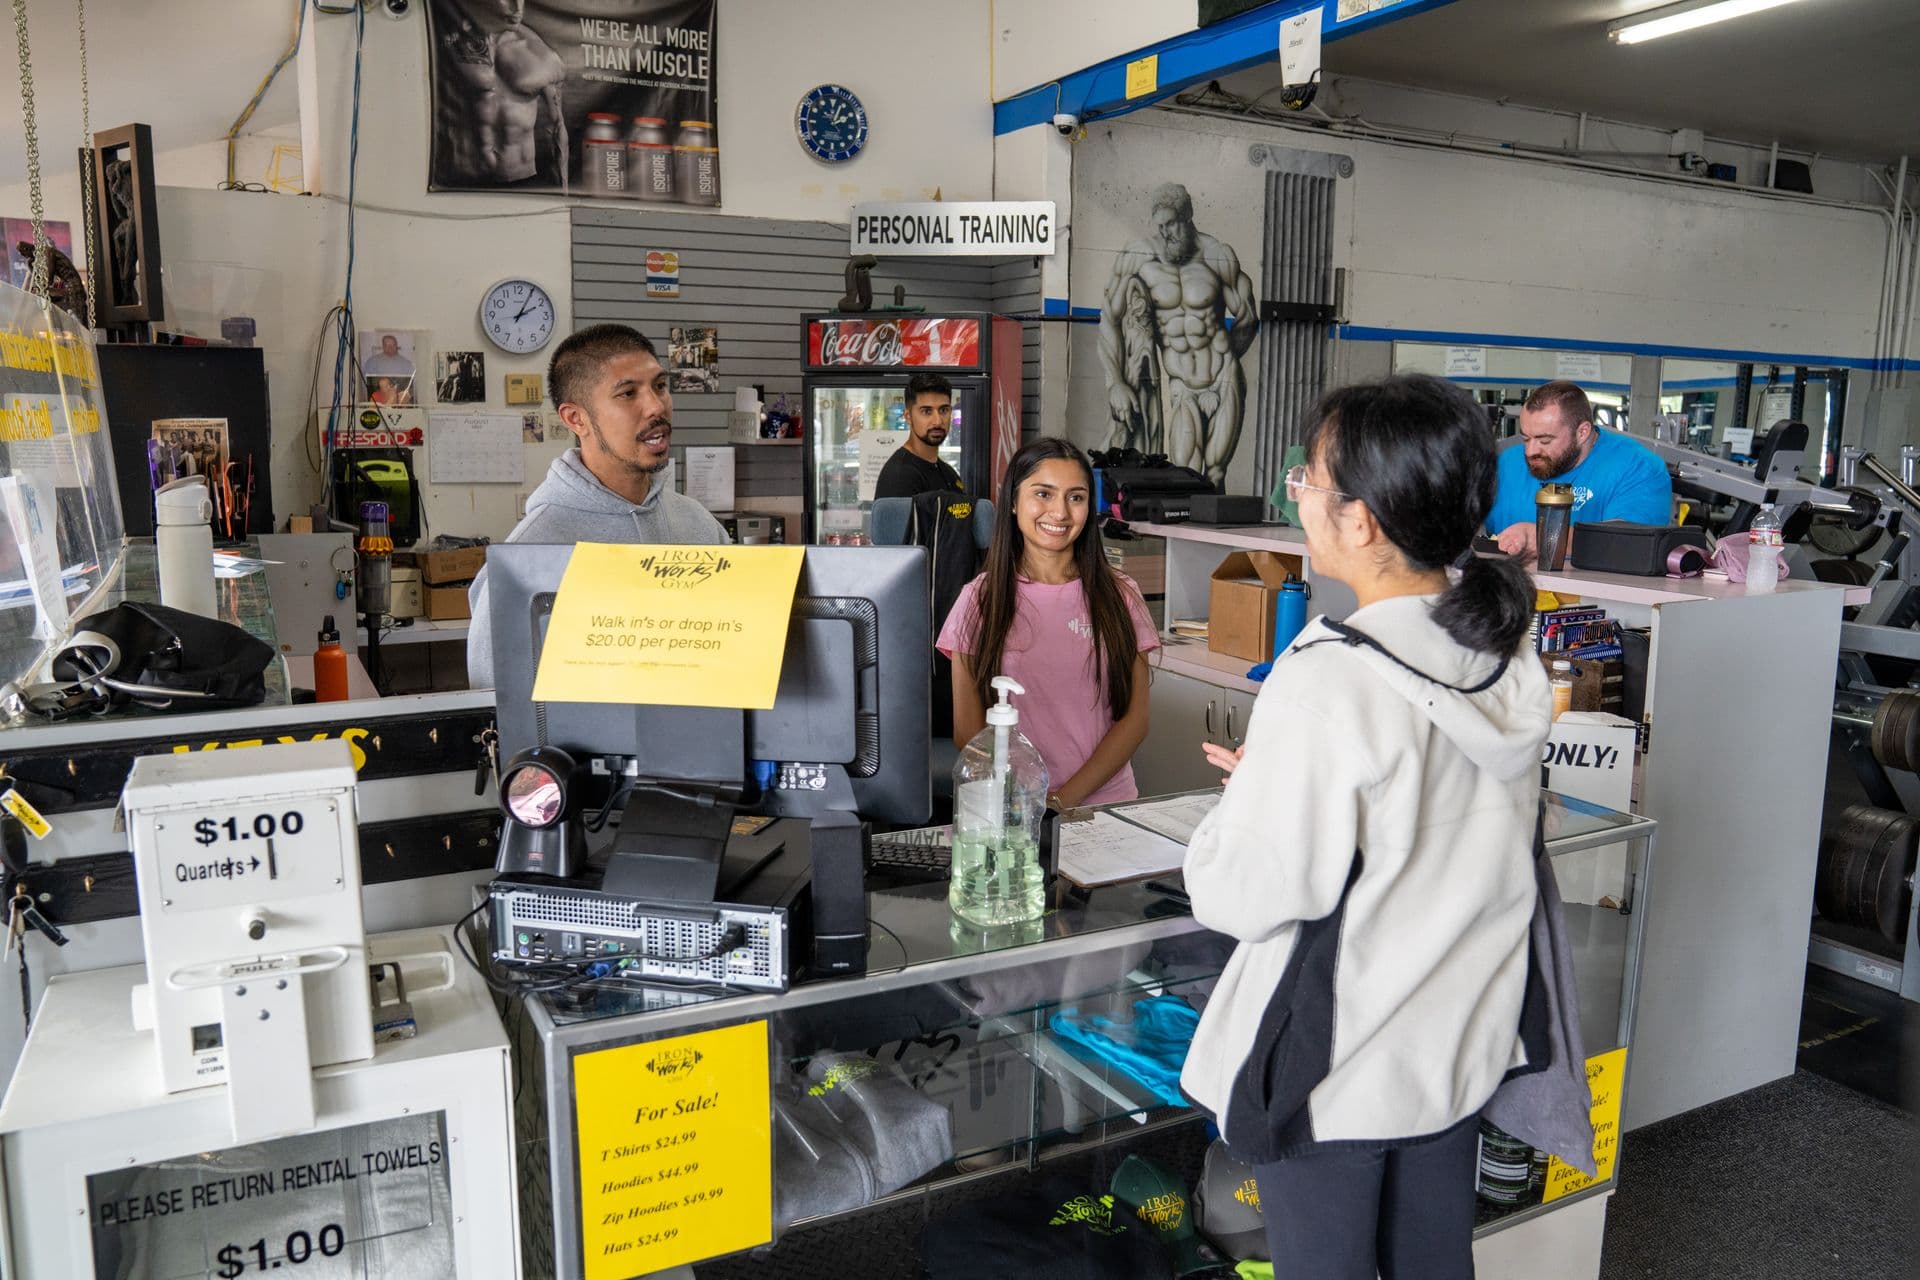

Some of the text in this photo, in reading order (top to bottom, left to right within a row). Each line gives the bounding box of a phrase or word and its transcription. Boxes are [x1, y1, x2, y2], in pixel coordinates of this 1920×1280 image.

[580, 18, 708, 50] WE'RE ALL MORE
[581, 43, 709, 80] THAN MUSCLE
[607, 151, 619, 191] ISOPURE
[653, 154, 666, 193] ISOPURE
[698, 157, 712, 195] ISOPURE
[857, 214, 1049, 244] PERSONAL TRAINING
[513, 285, 523, 295] 12
[655, 284, 671, 292] VISA
[494, 298, 544, 308] 10 2
[489, 311, 549, 321] 9 3
[495, 324, 546, 333] 8 4
[505, 333, 536, 346] 7 6 5
[661, 550, 719, 561] IRON
[591, 615, 743, 633] Walk in's or drop in's
[586, 634, 721, 651] $20.00 per person
[1541, 742, 1619, 770] ONLY!
[195, 811, 304, 847] $1.00
[176, 859, 245, 883] Quarters
[234, 962, 281, 975] PULL
[201, 1056, 218, 1065] COIN
[658, 1047, 692, 1062] IRON
[197, 1066, 225, 1075] RETURN
[635, 1092, 719, 1125] For Sale!
[601, 1131, 697, 1162] T Shirts $24.99
[101, 1141, 442, 1227] PLEASE RETURN RENTAL TOWELS
[601, 1162, 699, 1194] Hoodies $44.99
[602, 1188, 724, 1226] Zip Hoodies $49.99
[1146, 1191, 1178, 1210] IRON
[217, 1223, 345, 1280] $1.00
[603, 1229, 679, 1256] Hats $24.99
